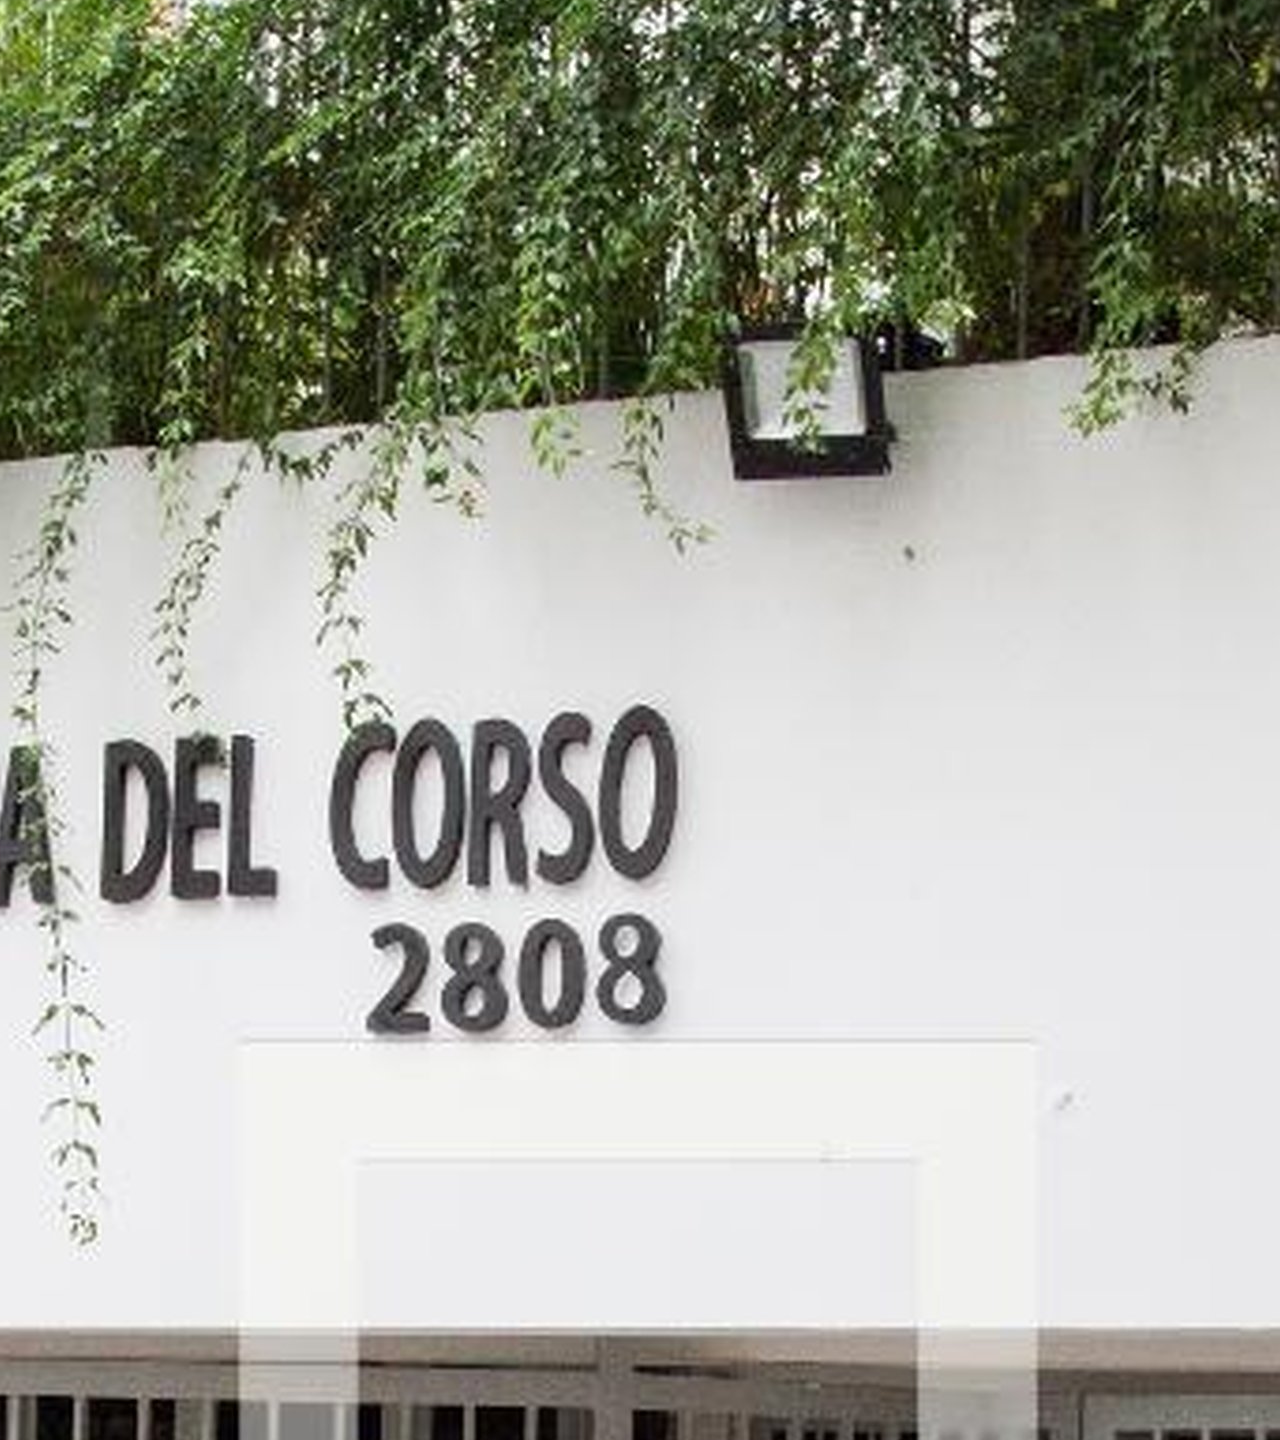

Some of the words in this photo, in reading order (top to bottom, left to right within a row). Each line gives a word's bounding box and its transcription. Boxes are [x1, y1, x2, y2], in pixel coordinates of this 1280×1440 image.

[99, 733, 279, 905] DEL
[329, 704, 679, 891] CORSO
[365, 913, 667, 1034] 2808
